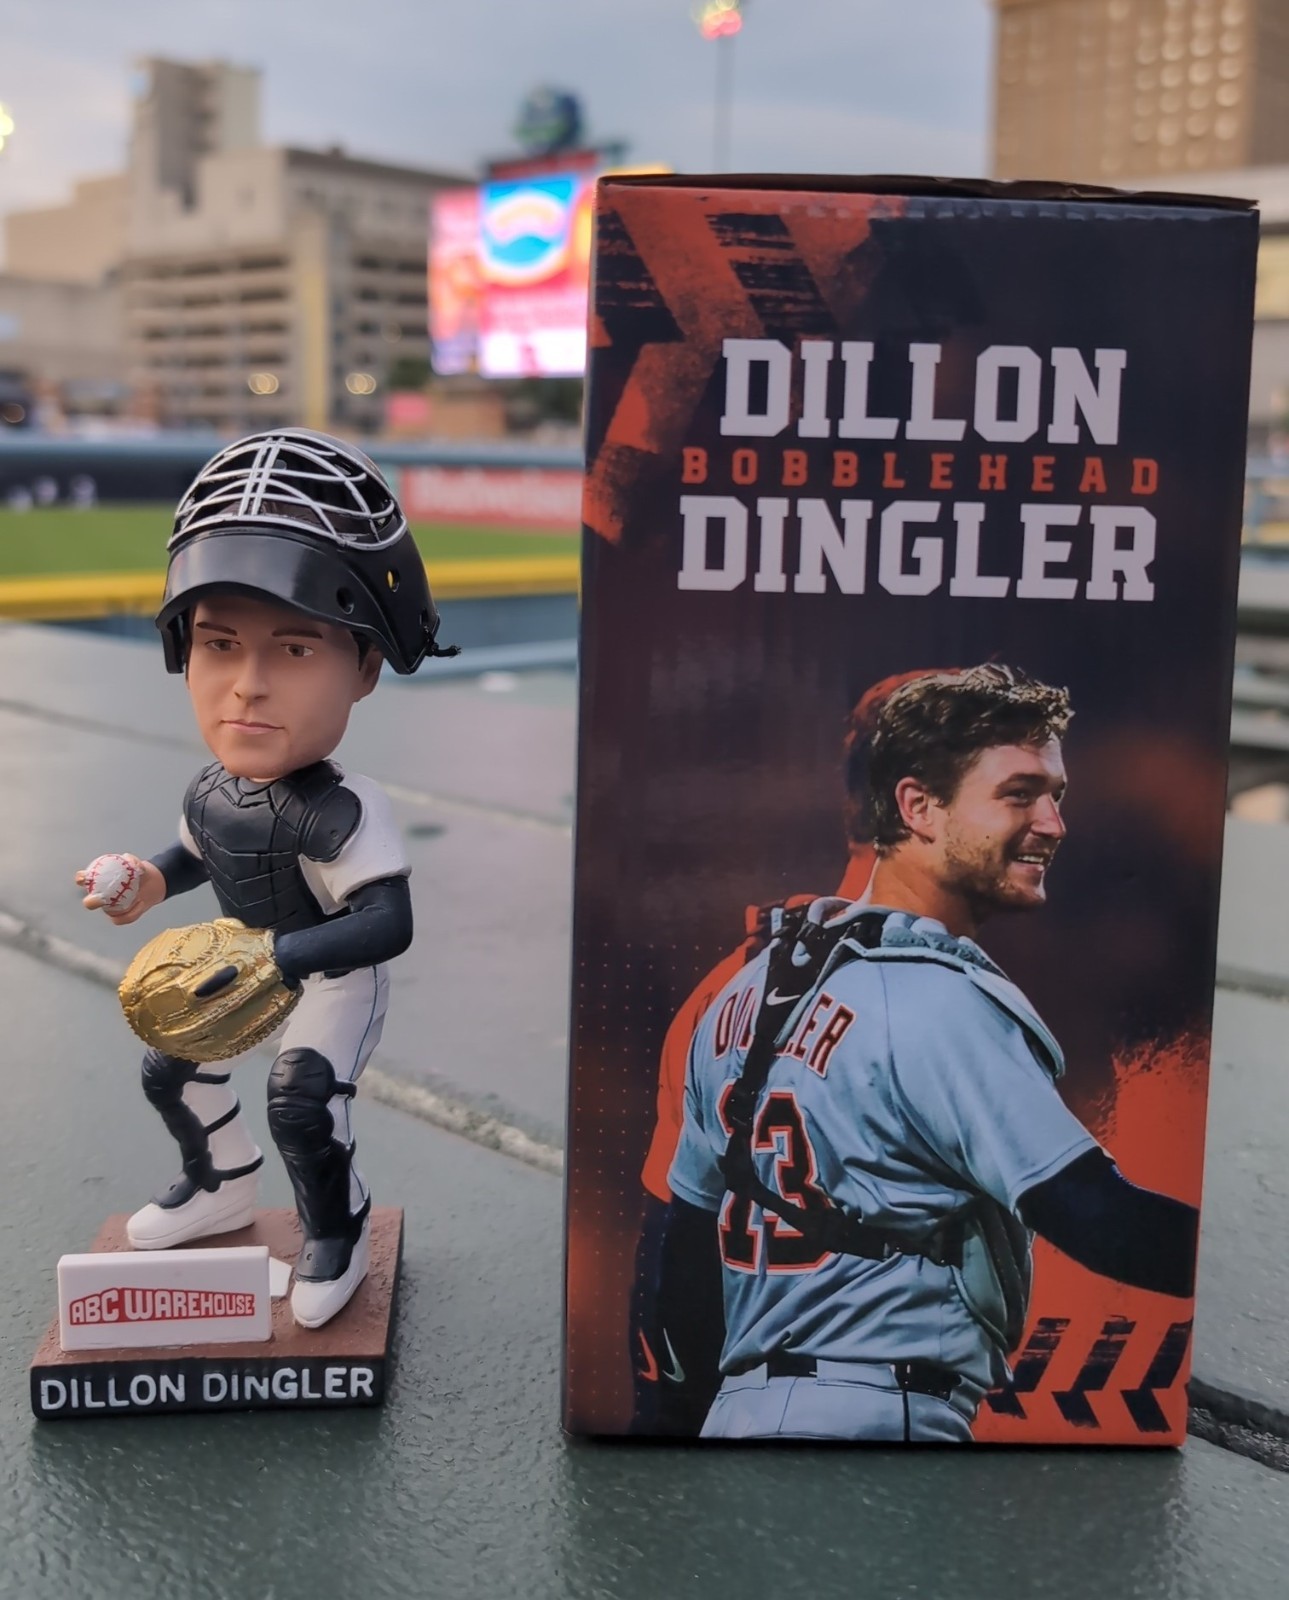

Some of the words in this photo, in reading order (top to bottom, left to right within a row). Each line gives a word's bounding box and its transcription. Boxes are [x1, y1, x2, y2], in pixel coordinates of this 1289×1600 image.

[720, 338, 1127, 445] DILLON
[681, 447, 1159, 495] BOBBLEHEAD
[677, 495, 1157, 601] DINGLER
[71, 1288, 120, 1324] ABC
[123, 1288, 254, 1321] WAREHOUSE
[40, 1373, 186, 1410] DILLON
[202, 1366, 374, 1403] DINGLER
